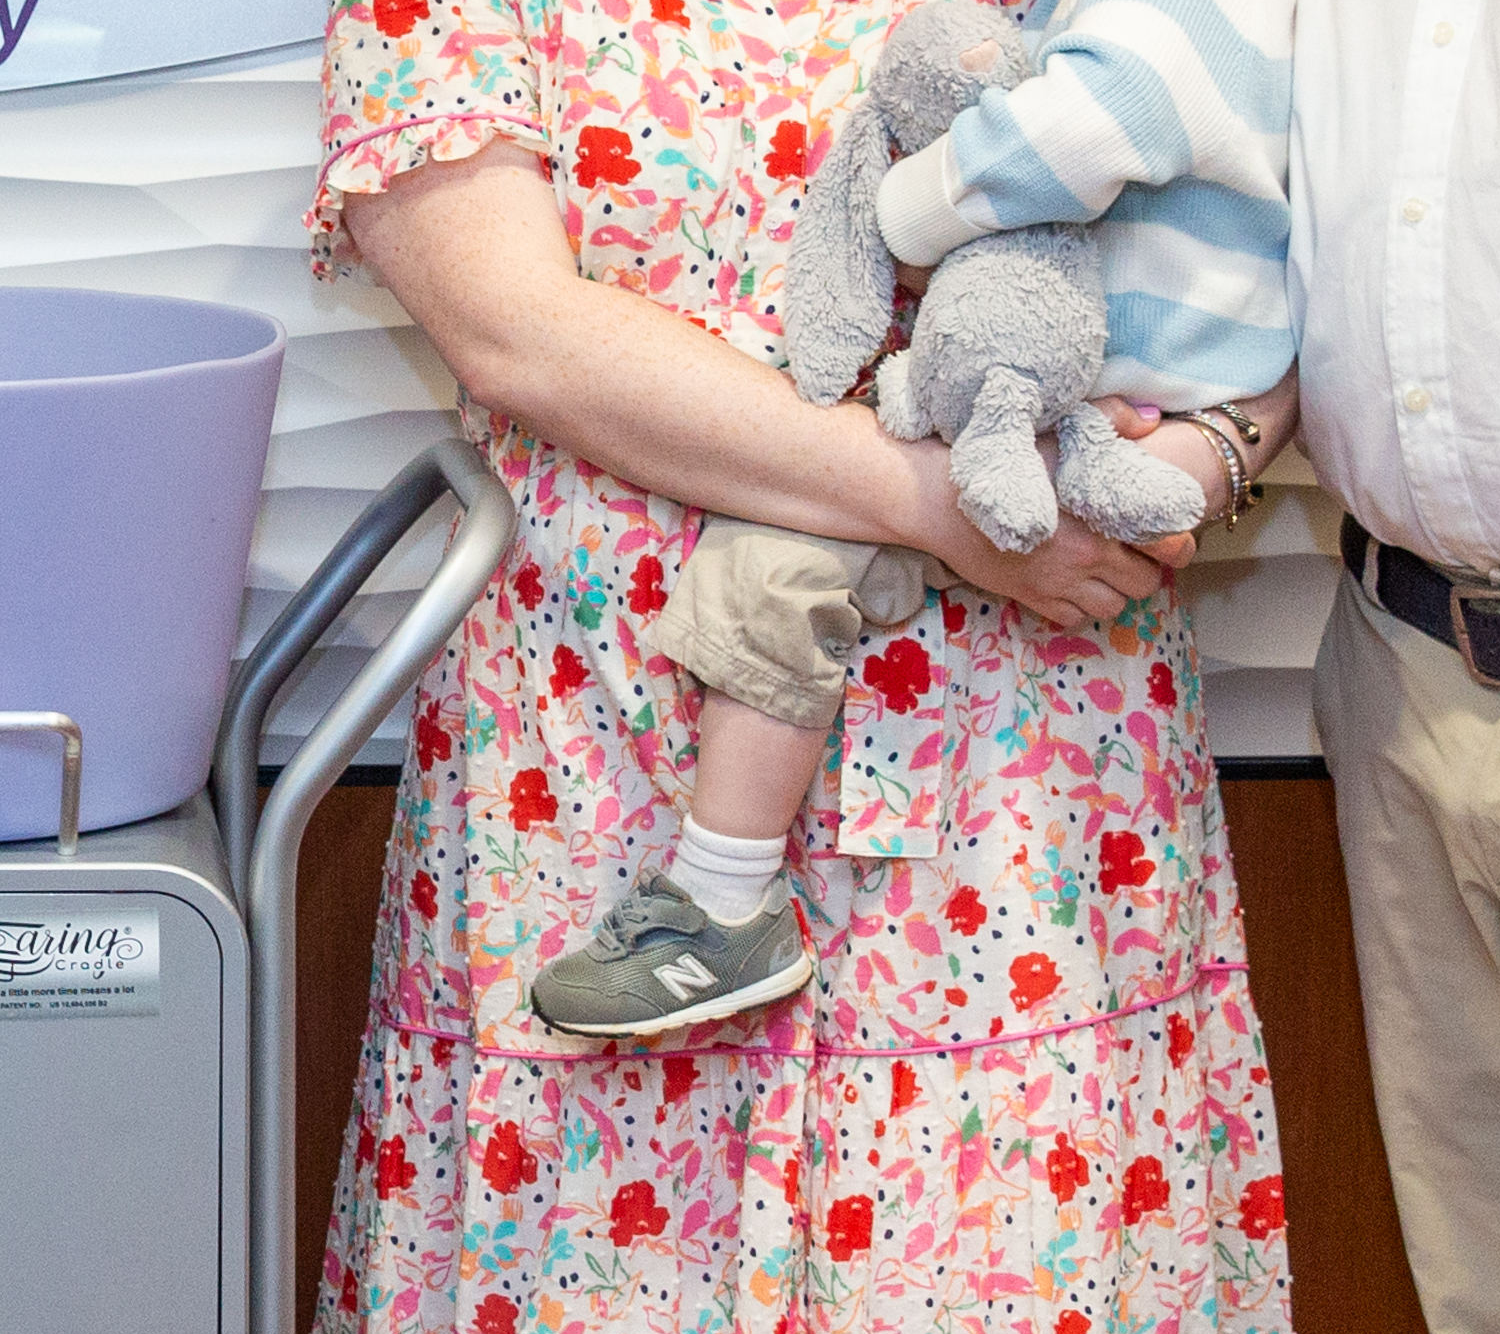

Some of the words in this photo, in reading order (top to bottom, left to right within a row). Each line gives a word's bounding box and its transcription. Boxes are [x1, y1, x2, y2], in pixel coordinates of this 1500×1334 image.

[8, 988, 29, 997] little
[57, 987, 77, 995] time
[80, 987, 111, 995] means
[122, 985, 135, 994] lot
